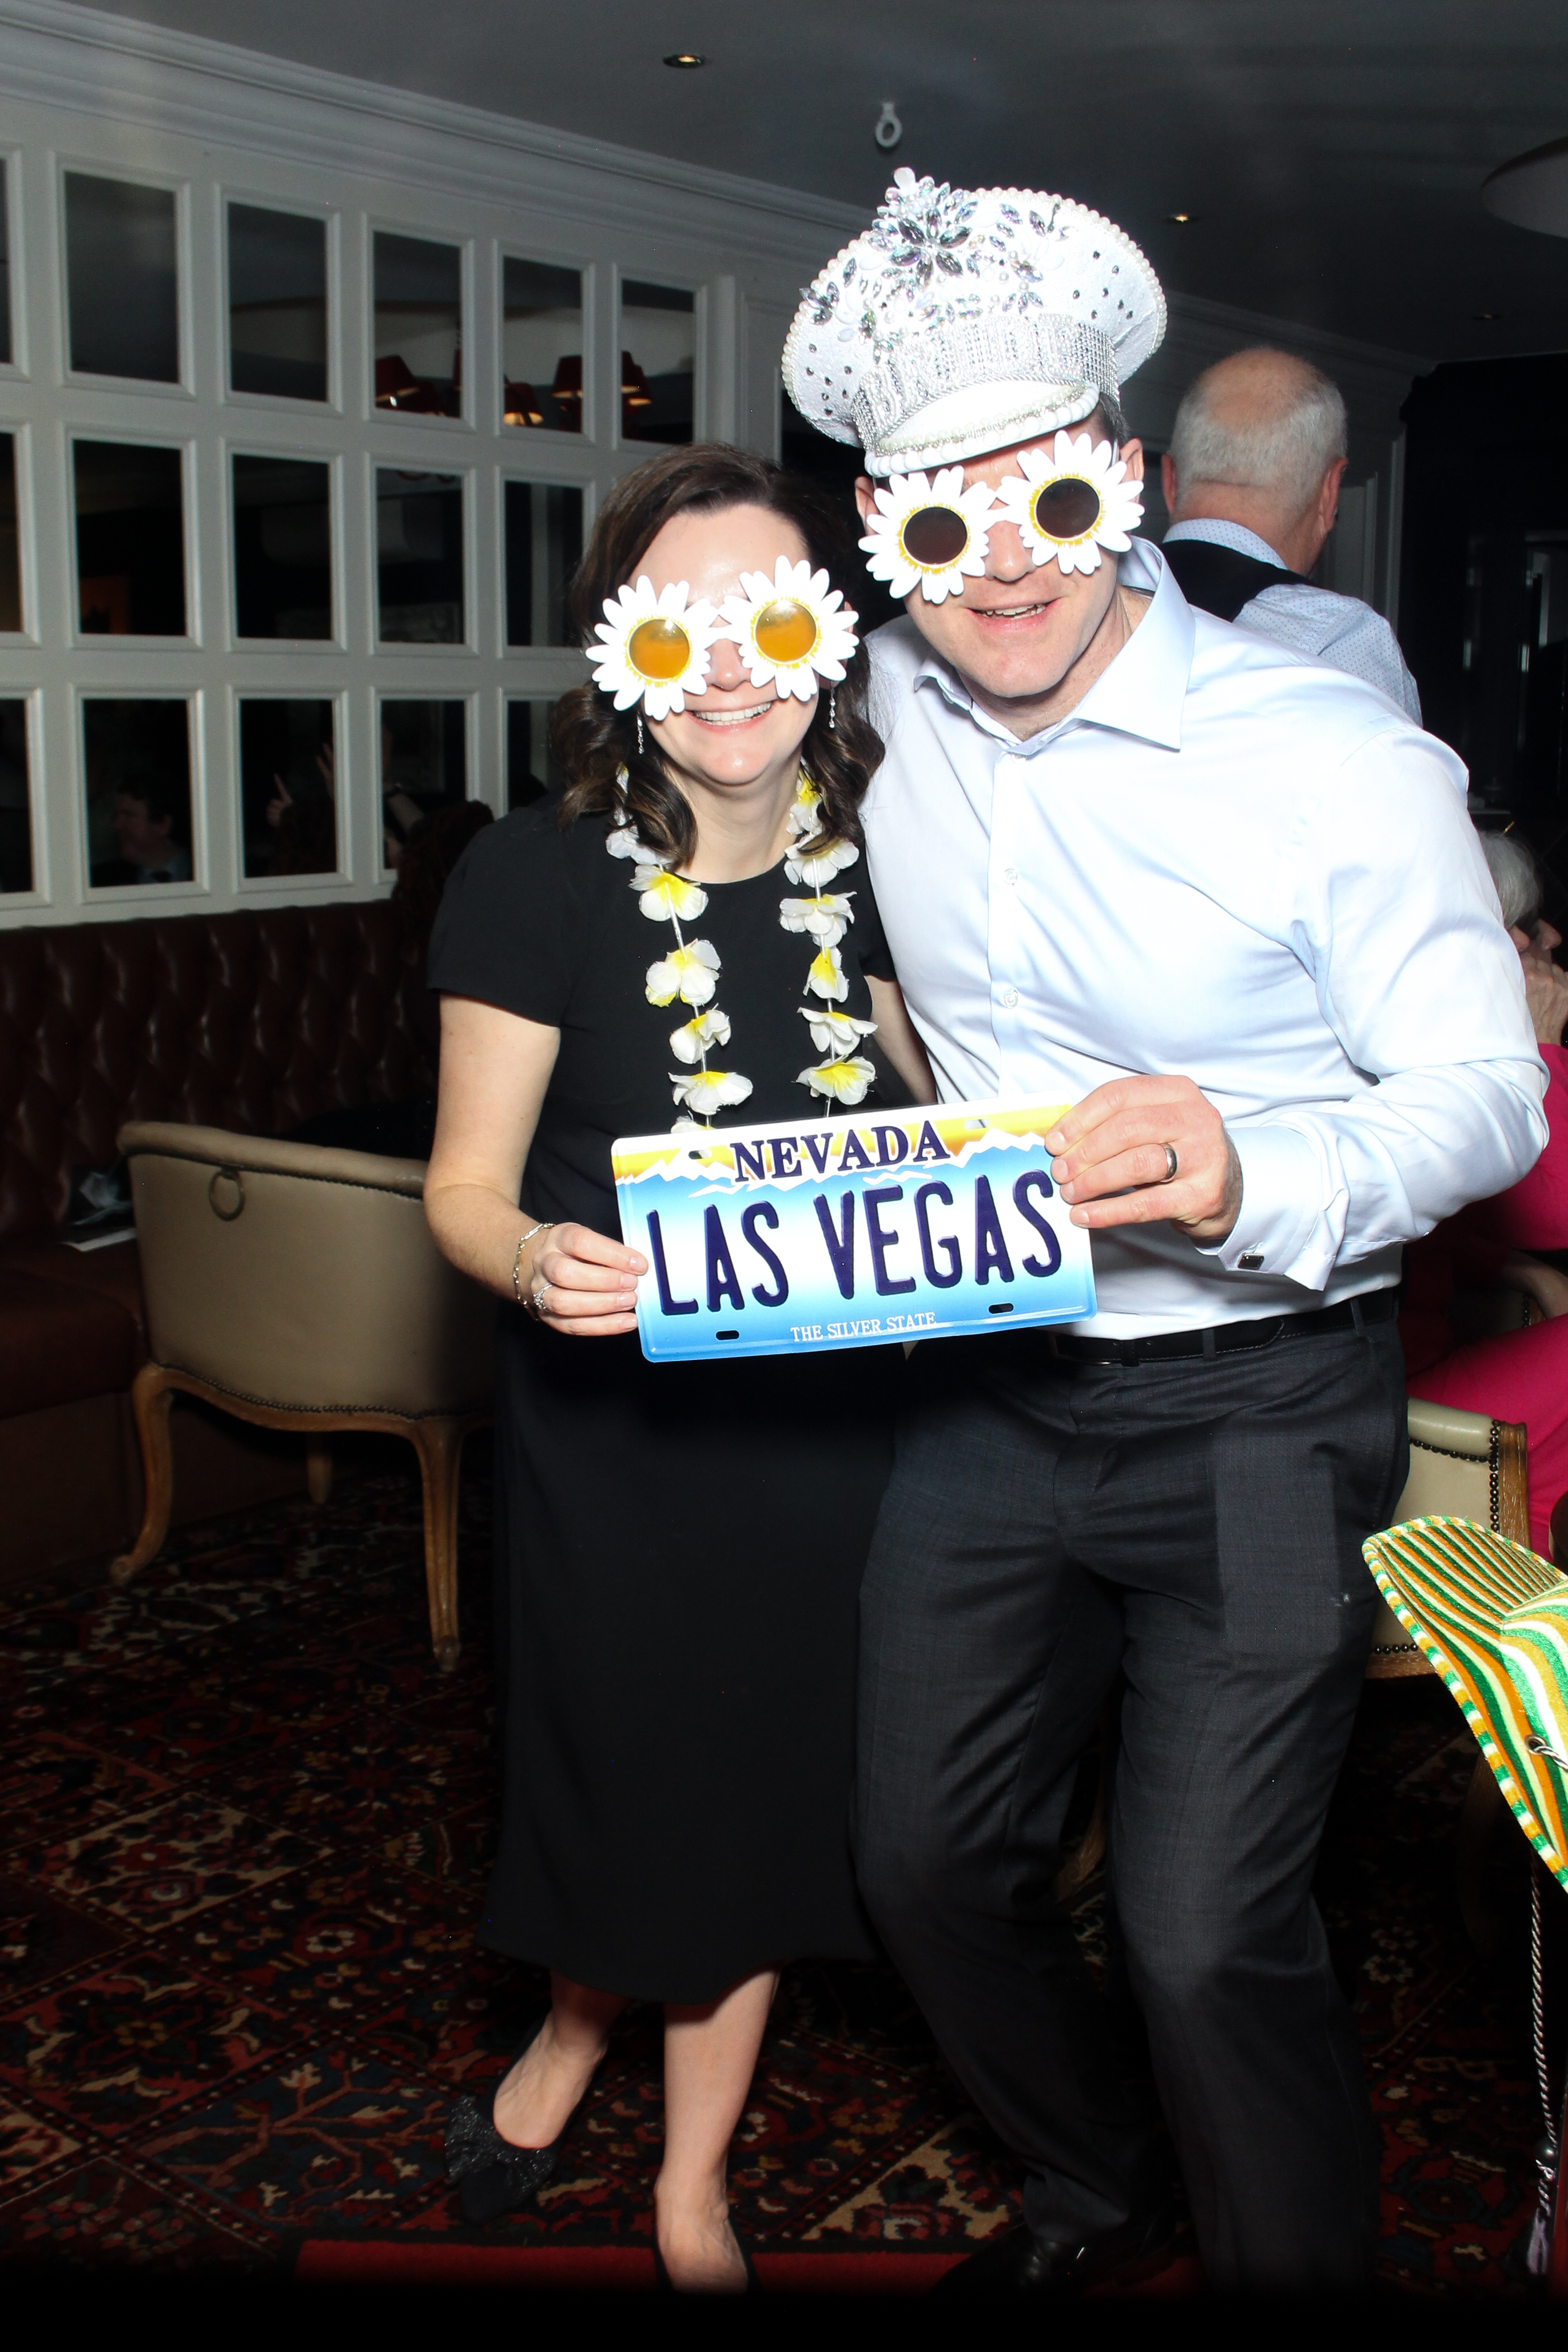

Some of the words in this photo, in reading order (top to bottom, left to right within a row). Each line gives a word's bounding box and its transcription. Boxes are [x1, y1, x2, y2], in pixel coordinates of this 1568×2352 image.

[730, 1120, 950, 1182] NEVADA
[646, 1200, 789, 1316] LAS
[813, 1168, 1062, 1300] VEGAS
[790, 1324, 823, 1342] THE
[827, 1318, 883, 1339] SILVER
[886, 1311, 937, 1332] STATE
